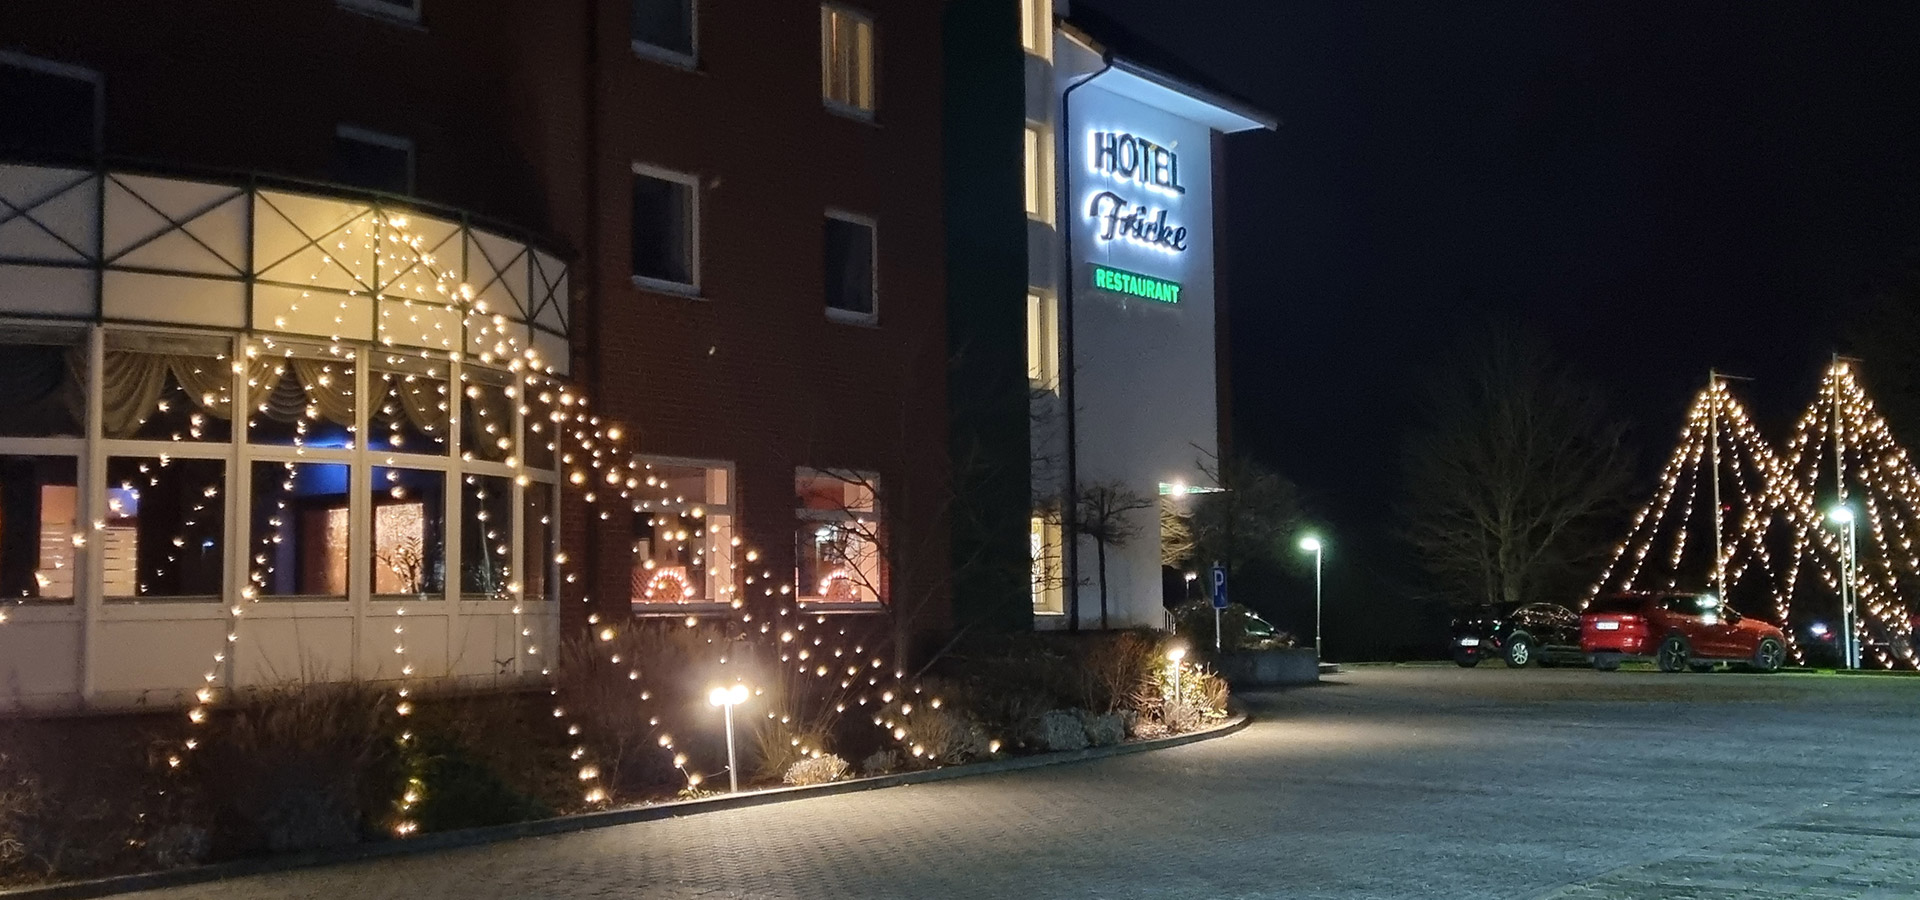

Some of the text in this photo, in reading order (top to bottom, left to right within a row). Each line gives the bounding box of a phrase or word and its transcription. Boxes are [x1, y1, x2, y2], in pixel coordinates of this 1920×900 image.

[1094, 131, 1185, 194] HOTEL
[1089, 191, 1187, 251] Fricke
[1096, 268, 1180, 304] RESTAURANT
[1214, 570, 1224, 596] P
